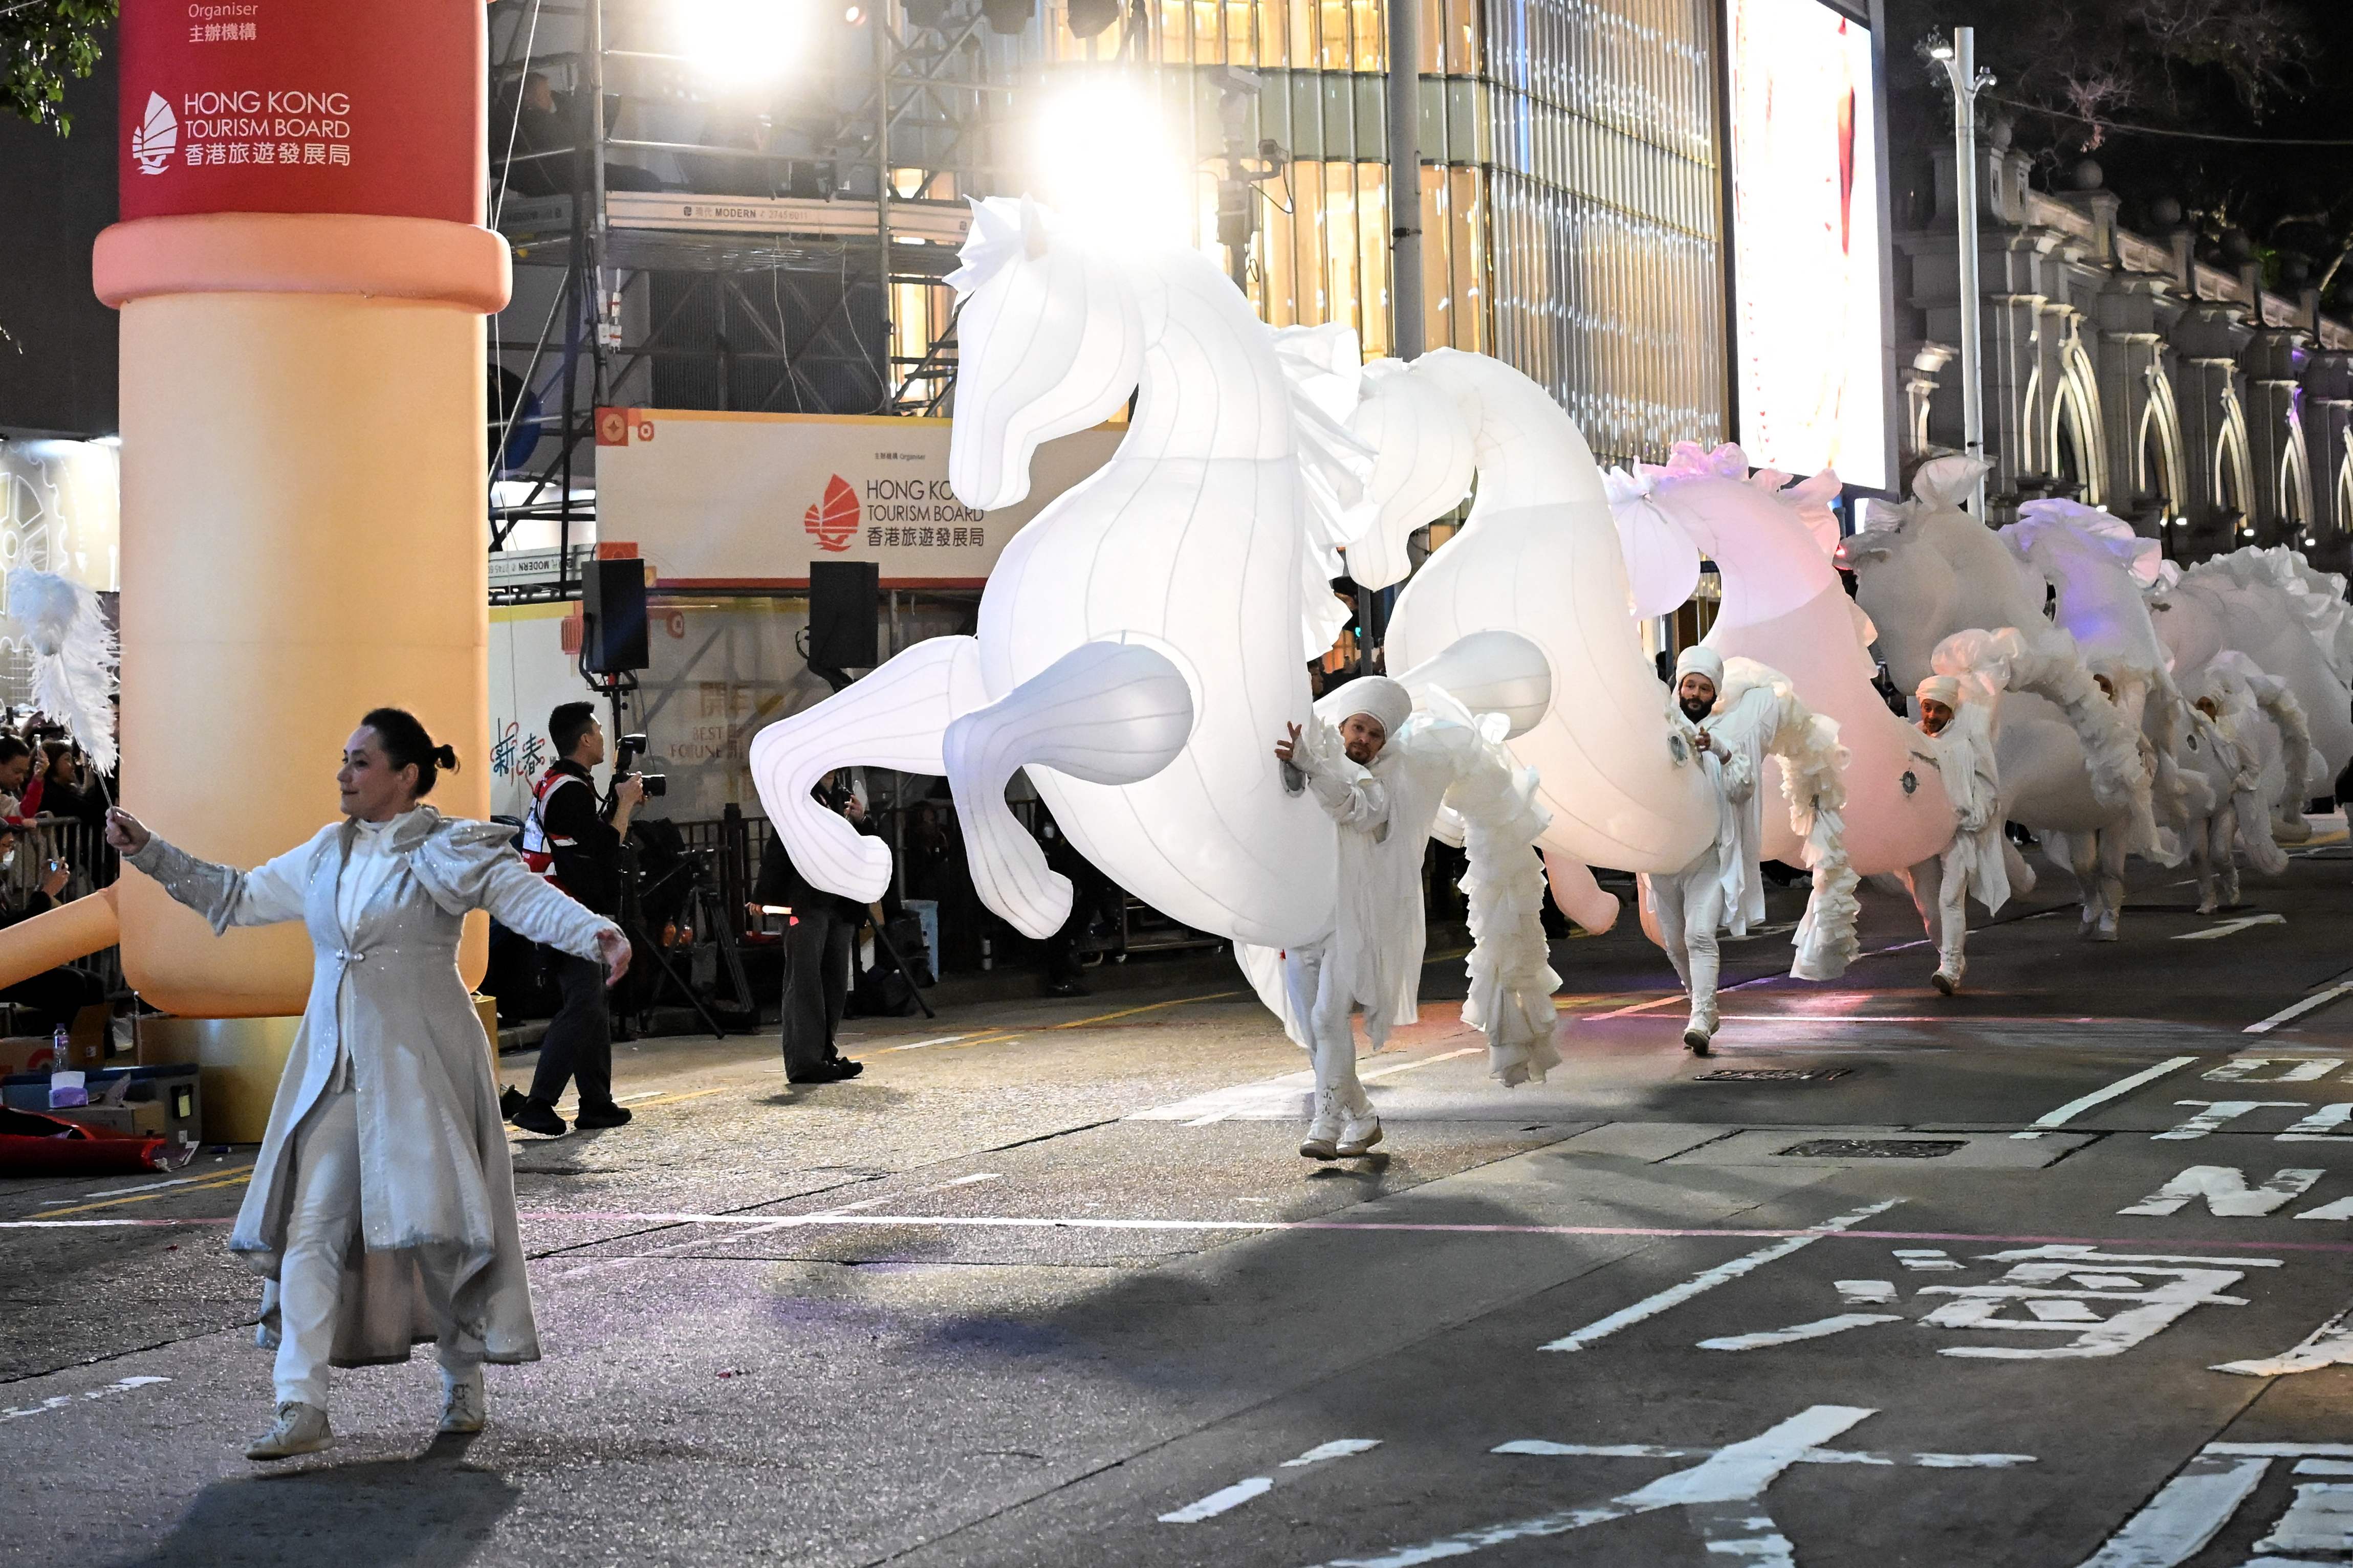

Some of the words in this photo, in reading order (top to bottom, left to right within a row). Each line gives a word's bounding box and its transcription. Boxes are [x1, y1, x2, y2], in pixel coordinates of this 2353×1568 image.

[188, 3, 258, 19] Organiser
[189, 22, 257, 42] 主辦機構
[185, 91, 261, 116] HONG
[269, 91, 350, 116] KONG
[185, 119, 269, 139] TOURISM
[275, 119, 350, 139] BOARD
[185, 143, 351, 166] 香港旅遊發展局
[715, 208, 756, 218] MODERN
[867, 480, 924, 500] HONG
[929, 480, 958, 500] KO
[868, 505, 930, 521] TOURISM
[934, 505, 984, 522] BOARD
[867, 527, 984, 546] 香港旅遊發展局
[519, 561, 549, 571] MODERN
[693, 726, 723, 741] BEST
[1696, 1244, 2353, 1377] 海
